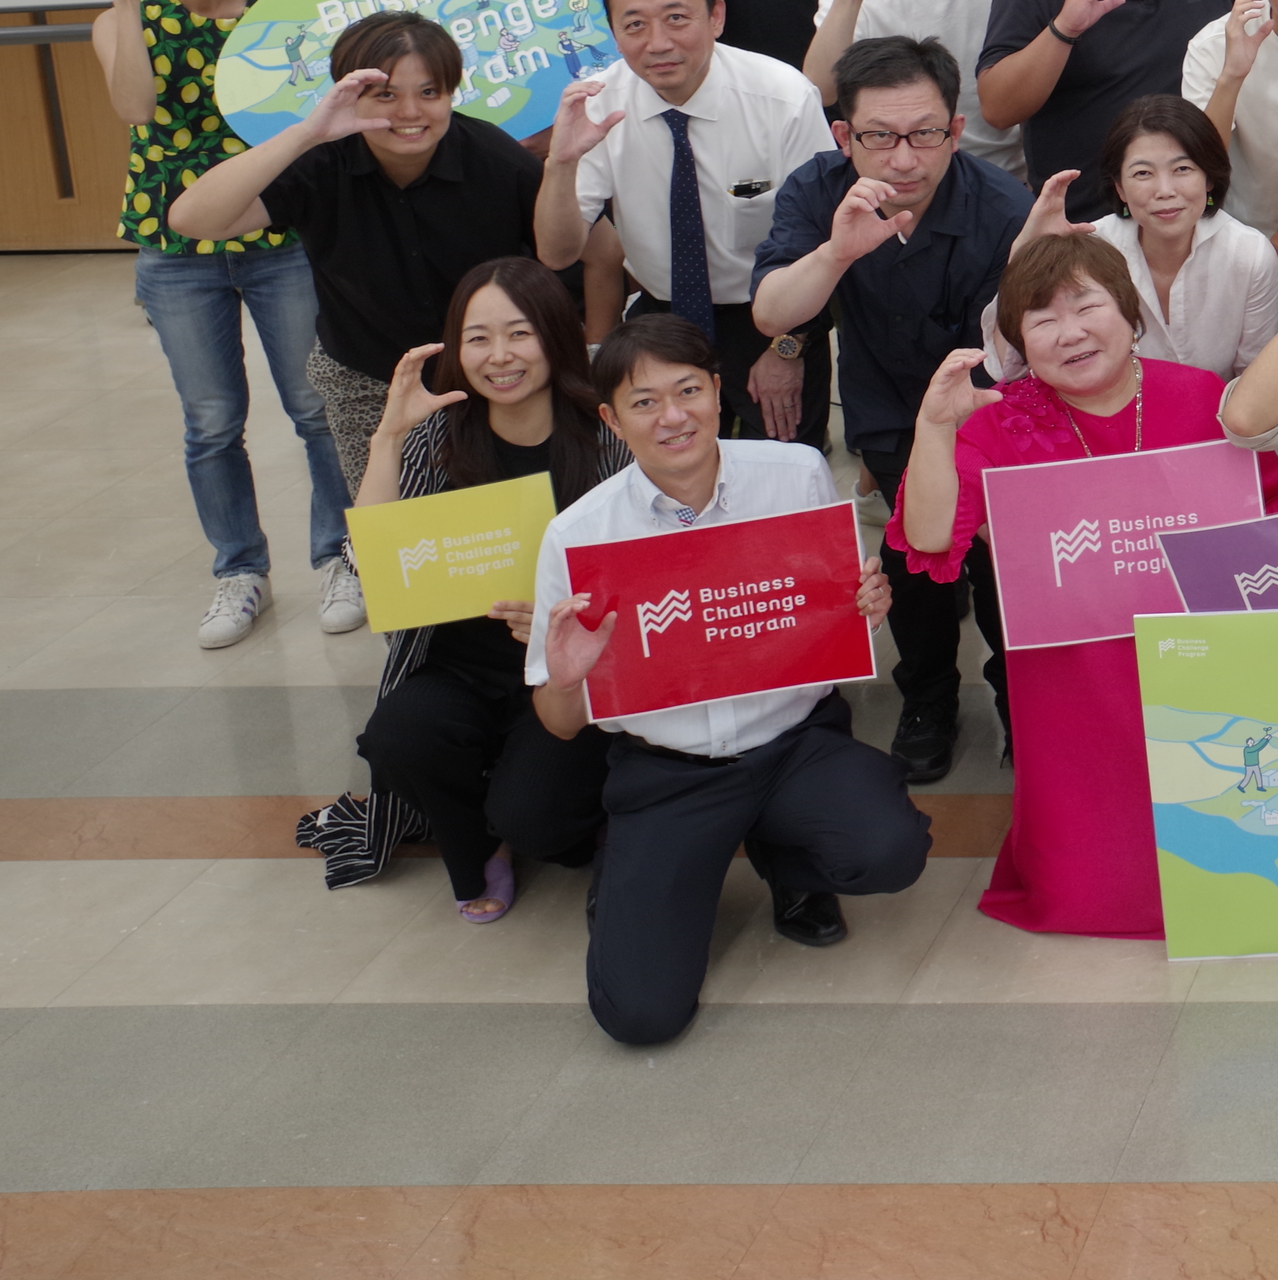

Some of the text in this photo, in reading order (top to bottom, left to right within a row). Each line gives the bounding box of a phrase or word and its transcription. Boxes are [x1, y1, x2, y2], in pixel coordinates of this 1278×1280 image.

[1108, 511, 1199, 534] Business
[442, 527, 512, 548] Business
[445, 541, 521, 563] Challenge
[448, 558, 515, 577] Program
[699, 576, 796, 603] Business
[702, 593, 807, 622] Challenge
[705, 615, 797, 642] Program
